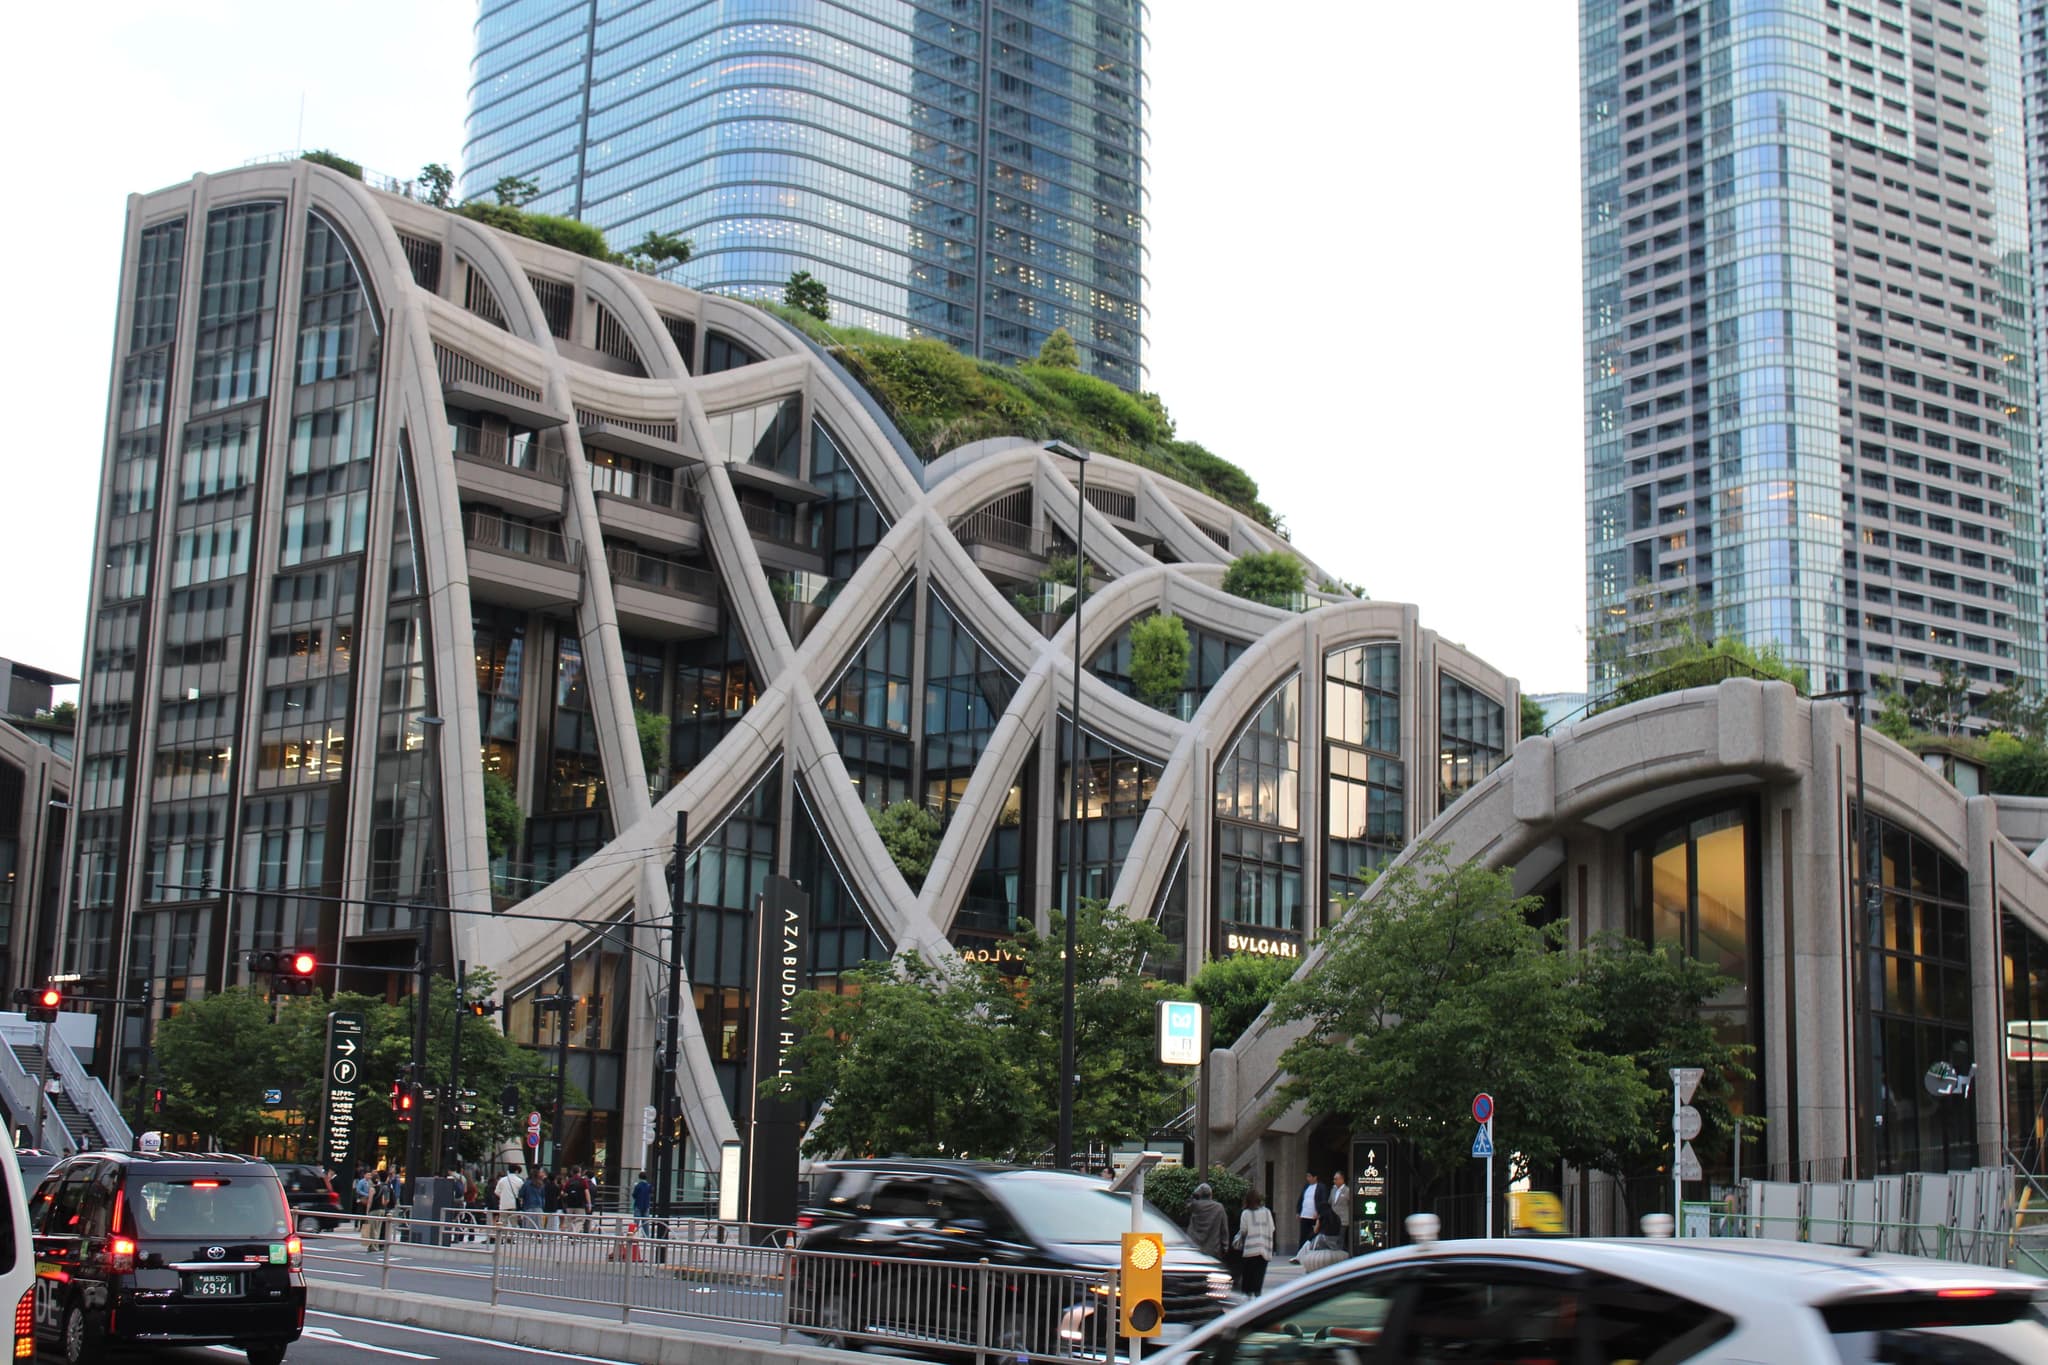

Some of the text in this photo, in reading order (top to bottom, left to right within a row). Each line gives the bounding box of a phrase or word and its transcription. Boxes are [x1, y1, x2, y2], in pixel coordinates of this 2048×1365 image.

[1228, 934, 1297, 958] BVLGARI
[780, 909, 799, 1021] AZABUDAI
[341, 1063, 351, 1080] P
[202, 1283, 232, 1294] 69-61
